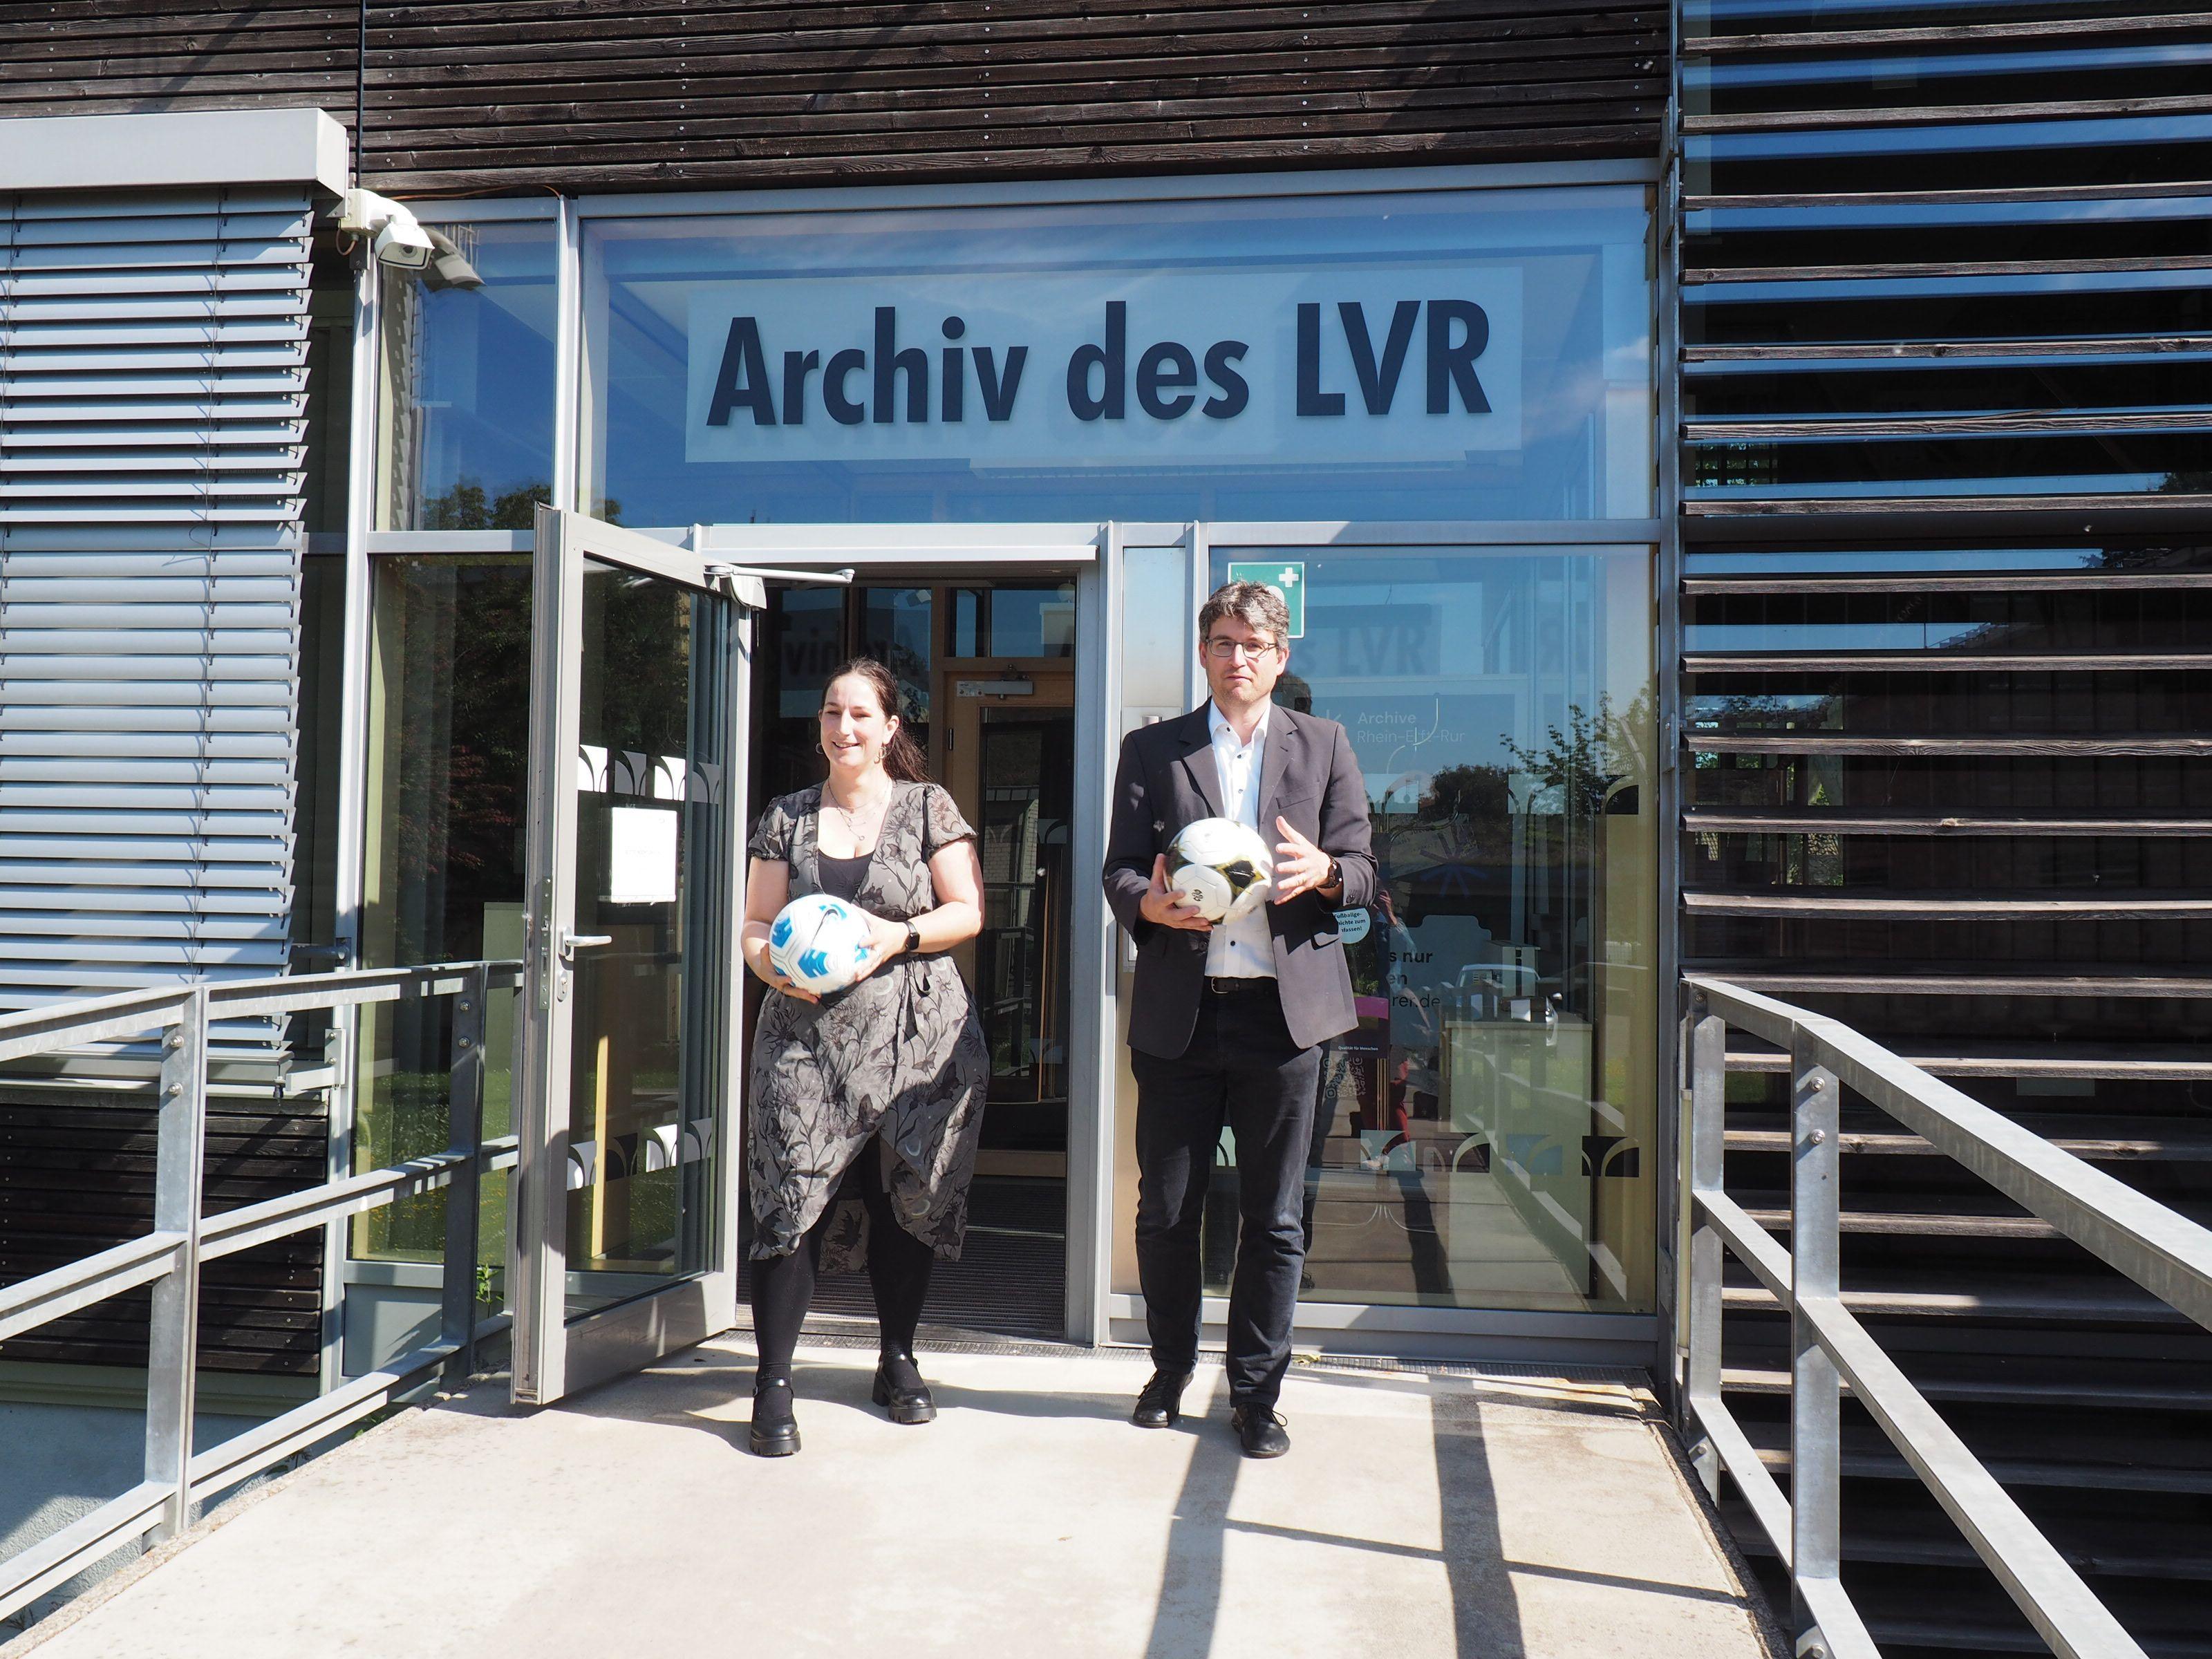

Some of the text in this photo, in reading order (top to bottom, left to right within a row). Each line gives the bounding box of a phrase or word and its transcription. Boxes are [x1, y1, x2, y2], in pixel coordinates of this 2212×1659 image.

[705, 299, 1493, 426] Archiv des LVR
[1358, 711, 1416, 724] Archive
[1403, 952, 1433, 963] nur
